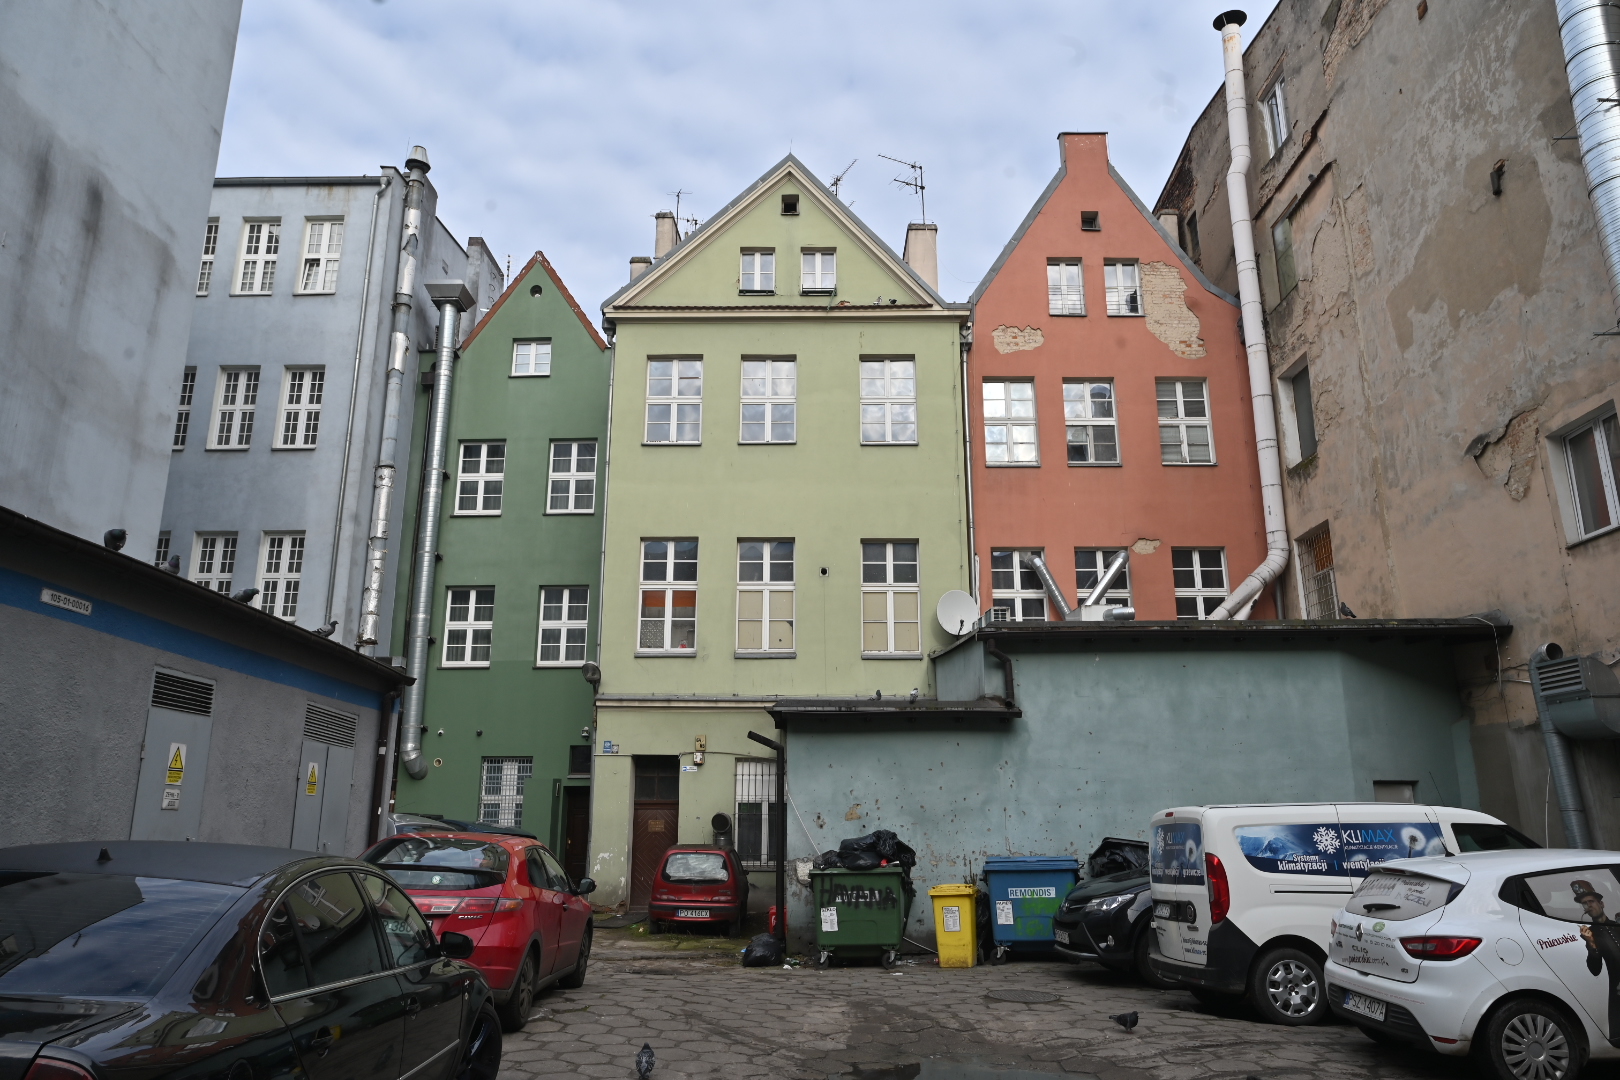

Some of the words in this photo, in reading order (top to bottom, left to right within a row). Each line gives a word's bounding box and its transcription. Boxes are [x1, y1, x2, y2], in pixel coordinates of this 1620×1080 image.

[1341, 829, 1397, 843] KLIMAX
[1292, 854, 1319, 863] Systemy
[1277, 860, 1328, 872] klimatyzacji
[1009, 888, 1052, 897] REMONDIS
[1351, 944, 1369, 954] CLIO
